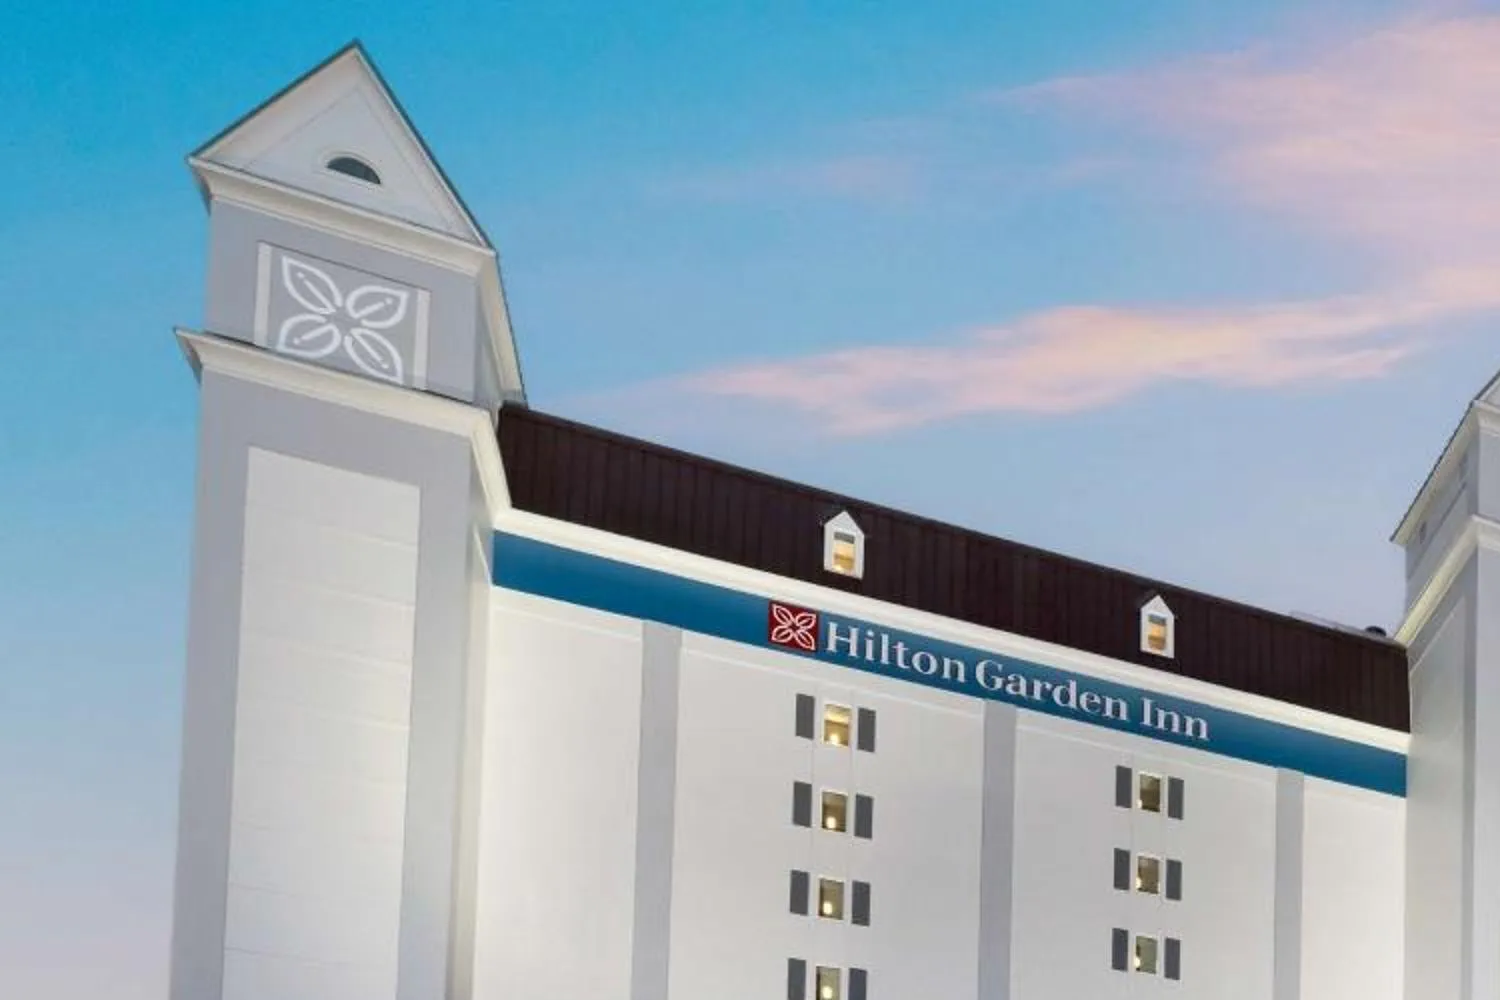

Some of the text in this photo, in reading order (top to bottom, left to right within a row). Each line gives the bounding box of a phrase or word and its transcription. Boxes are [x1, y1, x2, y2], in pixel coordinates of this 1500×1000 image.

[825, 621, 1210, 741] Hilton Garden Inn
